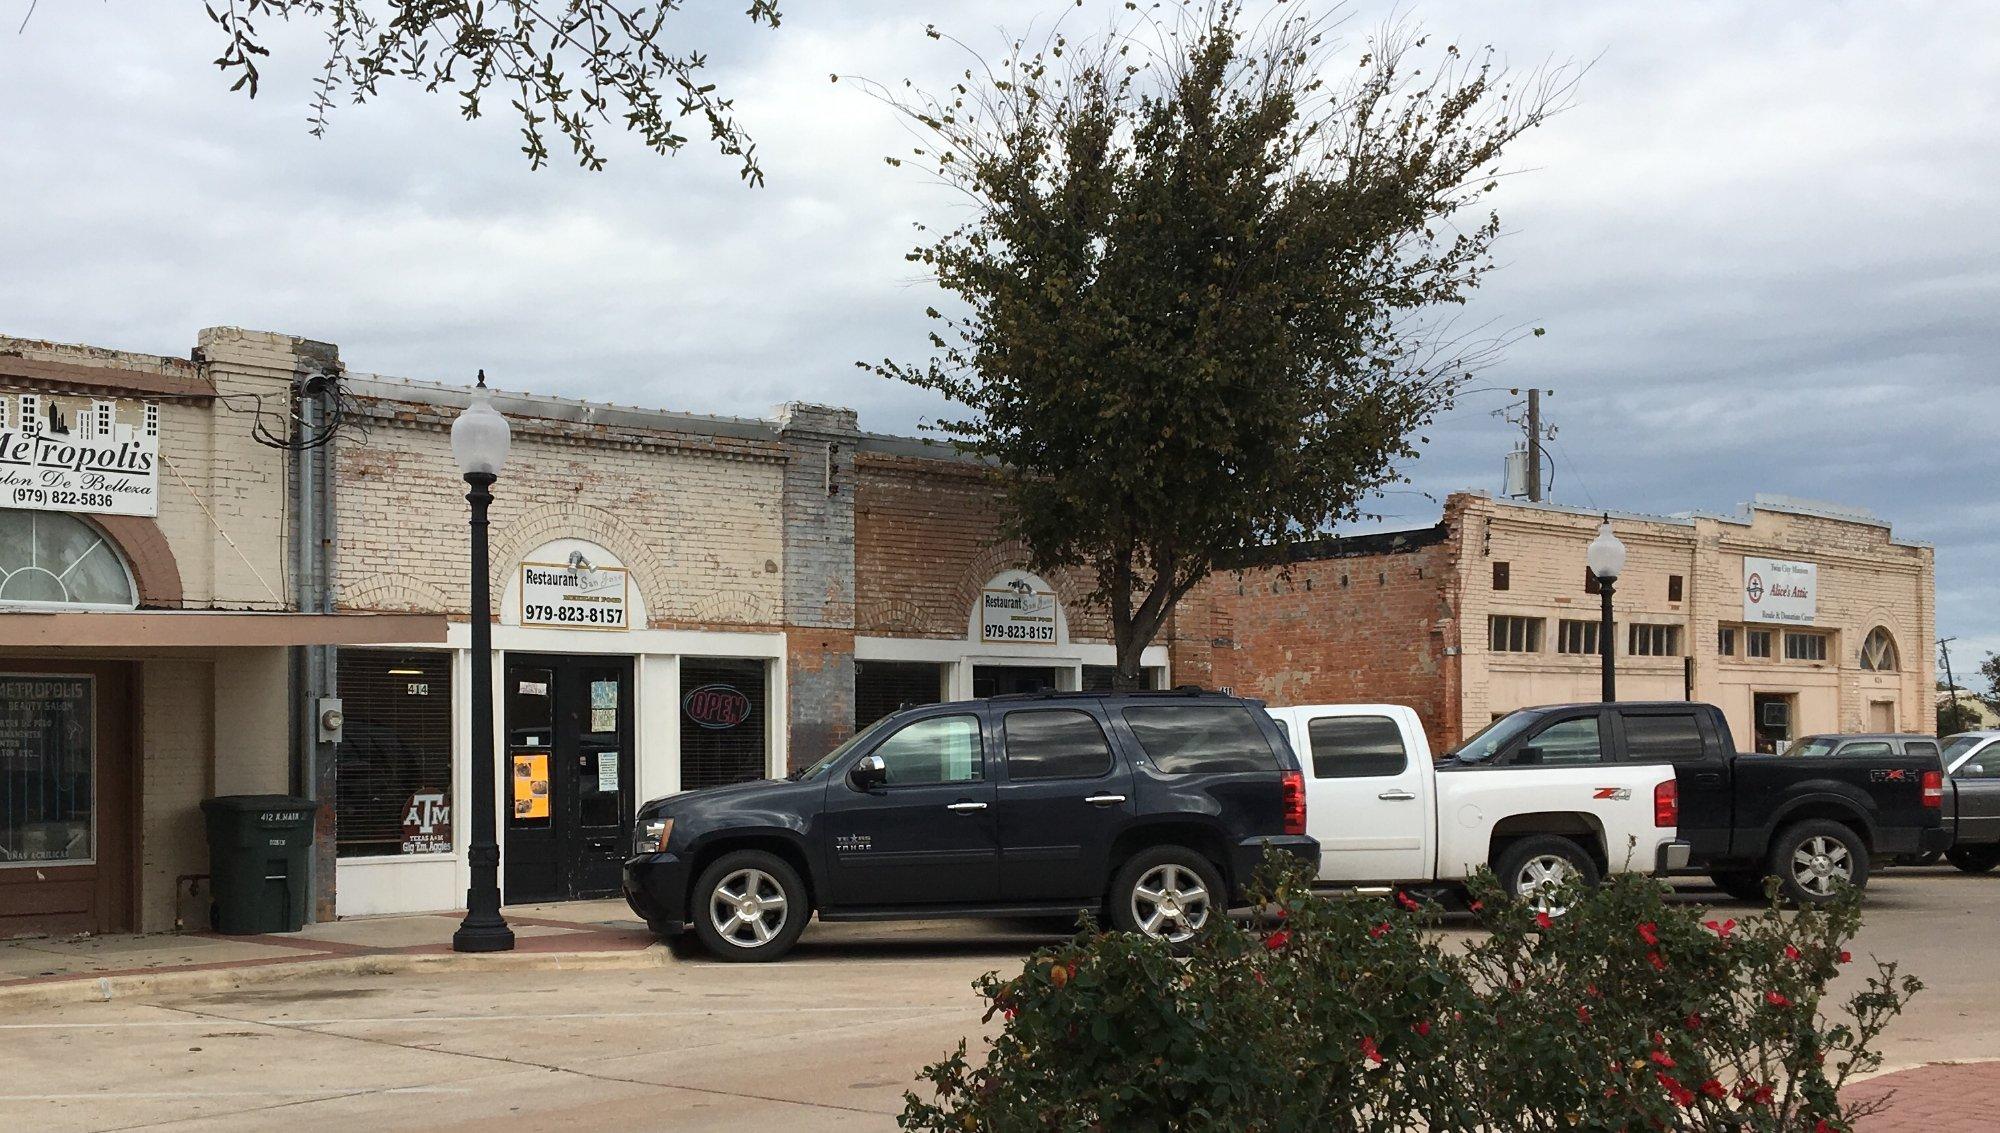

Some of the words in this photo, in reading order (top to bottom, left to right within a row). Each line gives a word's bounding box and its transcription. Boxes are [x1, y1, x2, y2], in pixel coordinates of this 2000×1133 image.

[39, 470, 72, 489] De
[80, 473, 152, 495] Belleza
[13, 488, 47, 505] (979)
[52, 490, 113, 507] 822-5836
[526, 569, 578, 587] Restaurant
[580, 576, 598, 590] San
[1791, 585, 1809, 599] Attic
[985, 595, 1021, 610] Restaurant
[525, 604, 623, 624] 979-823-8157
[985, 625, 1053, 639] 979-823-8157
[407, 684, 429, 695] 414
[8, 701, 41, 711] BEAUTY
[44, 702, 73, 711] SALON
[691, 691, 744, 726] OPEN
[1593, 787, 1631, 800] Z71
[260, 813, 273, 821] 412
[403, 842, 414, 855] Gig
